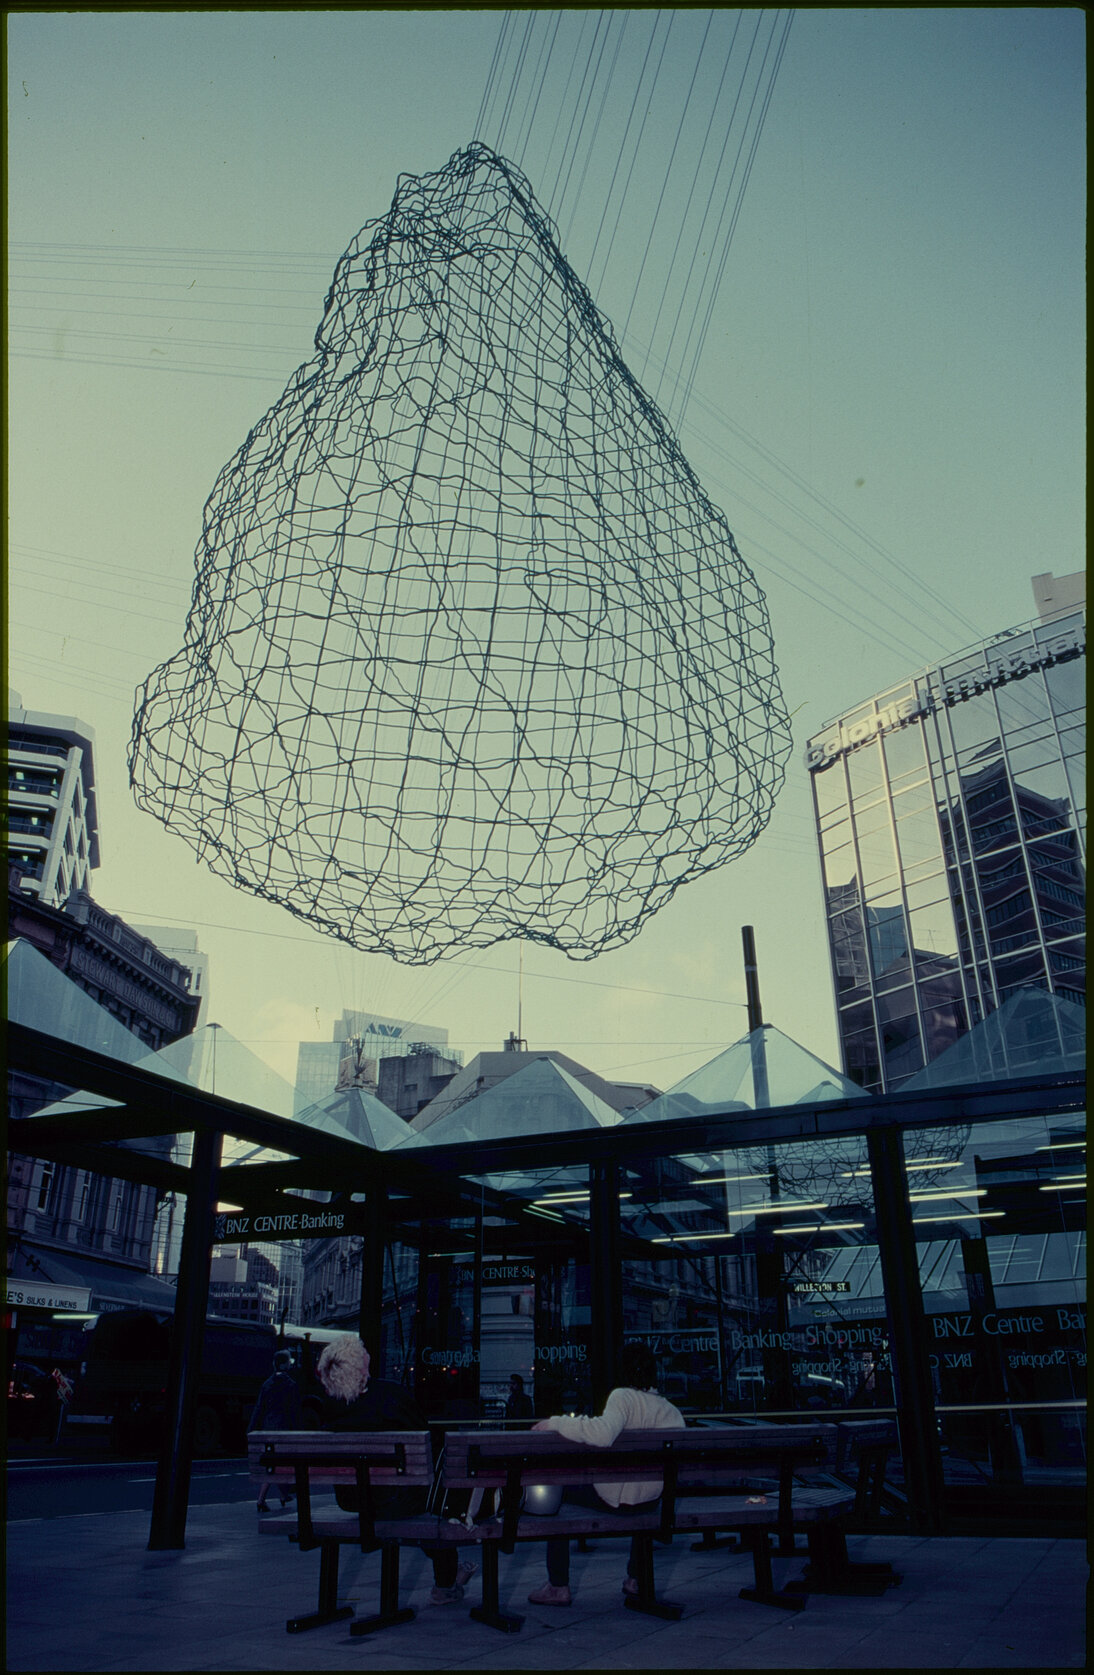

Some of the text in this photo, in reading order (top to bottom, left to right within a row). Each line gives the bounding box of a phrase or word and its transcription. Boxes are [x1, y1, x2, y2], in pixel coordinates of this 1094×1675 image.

[226, 1217, 249, 1234] BNZ
[26, 1296, 46, 1306] SILKS
[55, 1299, 77, 1309] LINENS
[932, 1315, 976, 1338] BNZ
[982, 1313, 1045, 1335] Centre
[730, 1328, 793, 1350] Banking
[806, 1323, 883, 1349] Shopping
